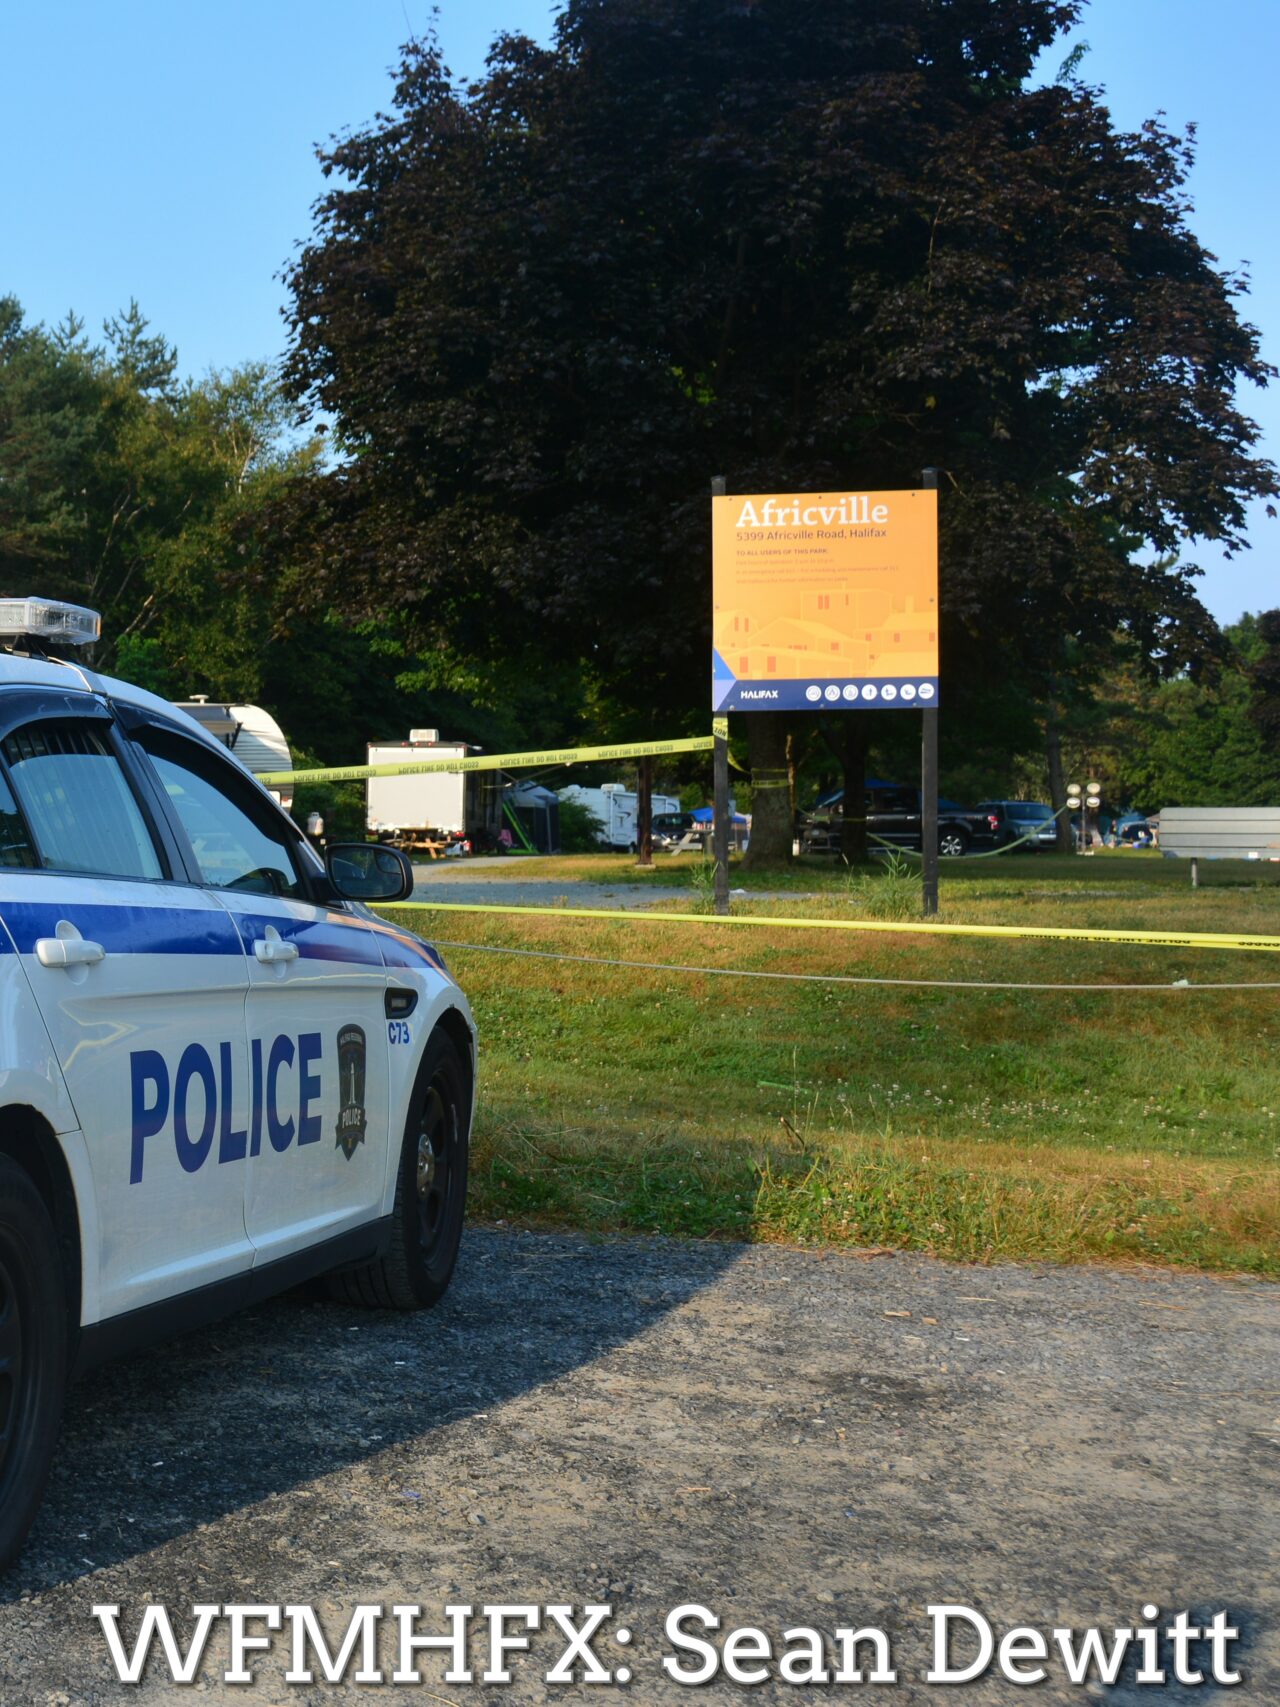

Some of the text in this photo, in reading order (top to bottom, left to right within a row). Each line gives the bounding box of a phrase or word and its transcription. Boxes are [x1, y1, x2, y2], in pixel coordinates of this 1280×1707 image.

[735, 495, 889, 528] Africville
[736, 527, 887, 541] 5399 Africville Road, Halifax
[740, 689, 778, 700] HALIFAX
[388, 1021, 410, 1045] C73
[129, 1032, 322, 1185] POLICE
[341, 1107, 362, 1129] POLICE
